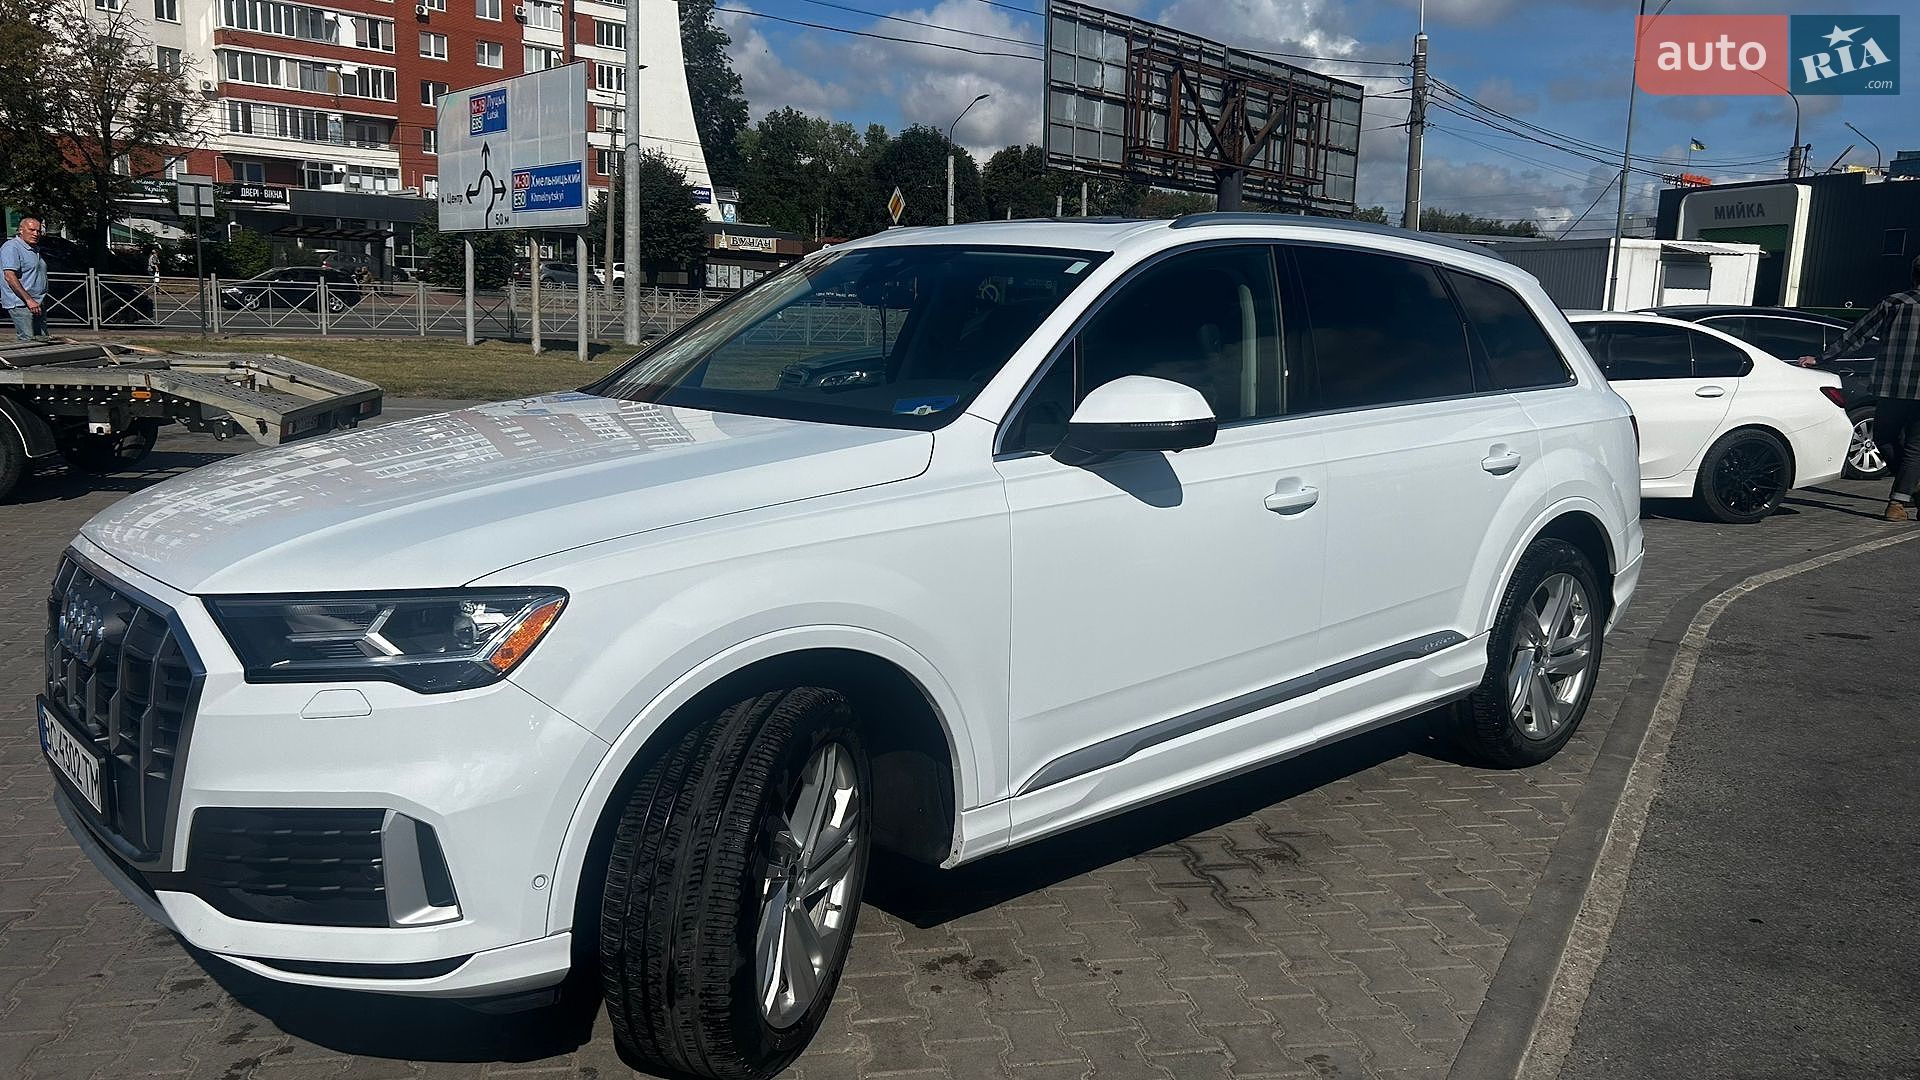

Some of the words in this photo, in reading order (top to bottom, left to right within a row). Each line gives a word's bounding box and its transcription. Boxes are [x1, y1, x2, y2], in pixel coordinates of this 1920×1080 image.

[487, 95, 506, 110] Луцьк
[530, 169, 581, 187] Хмельницький
[240, 187, 260, 197] ДВЕРІ
[264, 189, 283, 199] ВІКНА
[446, 193, 463, 205] Центр
[513, 192, 526, 206] E50
[1714, 201, 1766, 220] МИЙКА
[495, 213, 504, 225] 50
